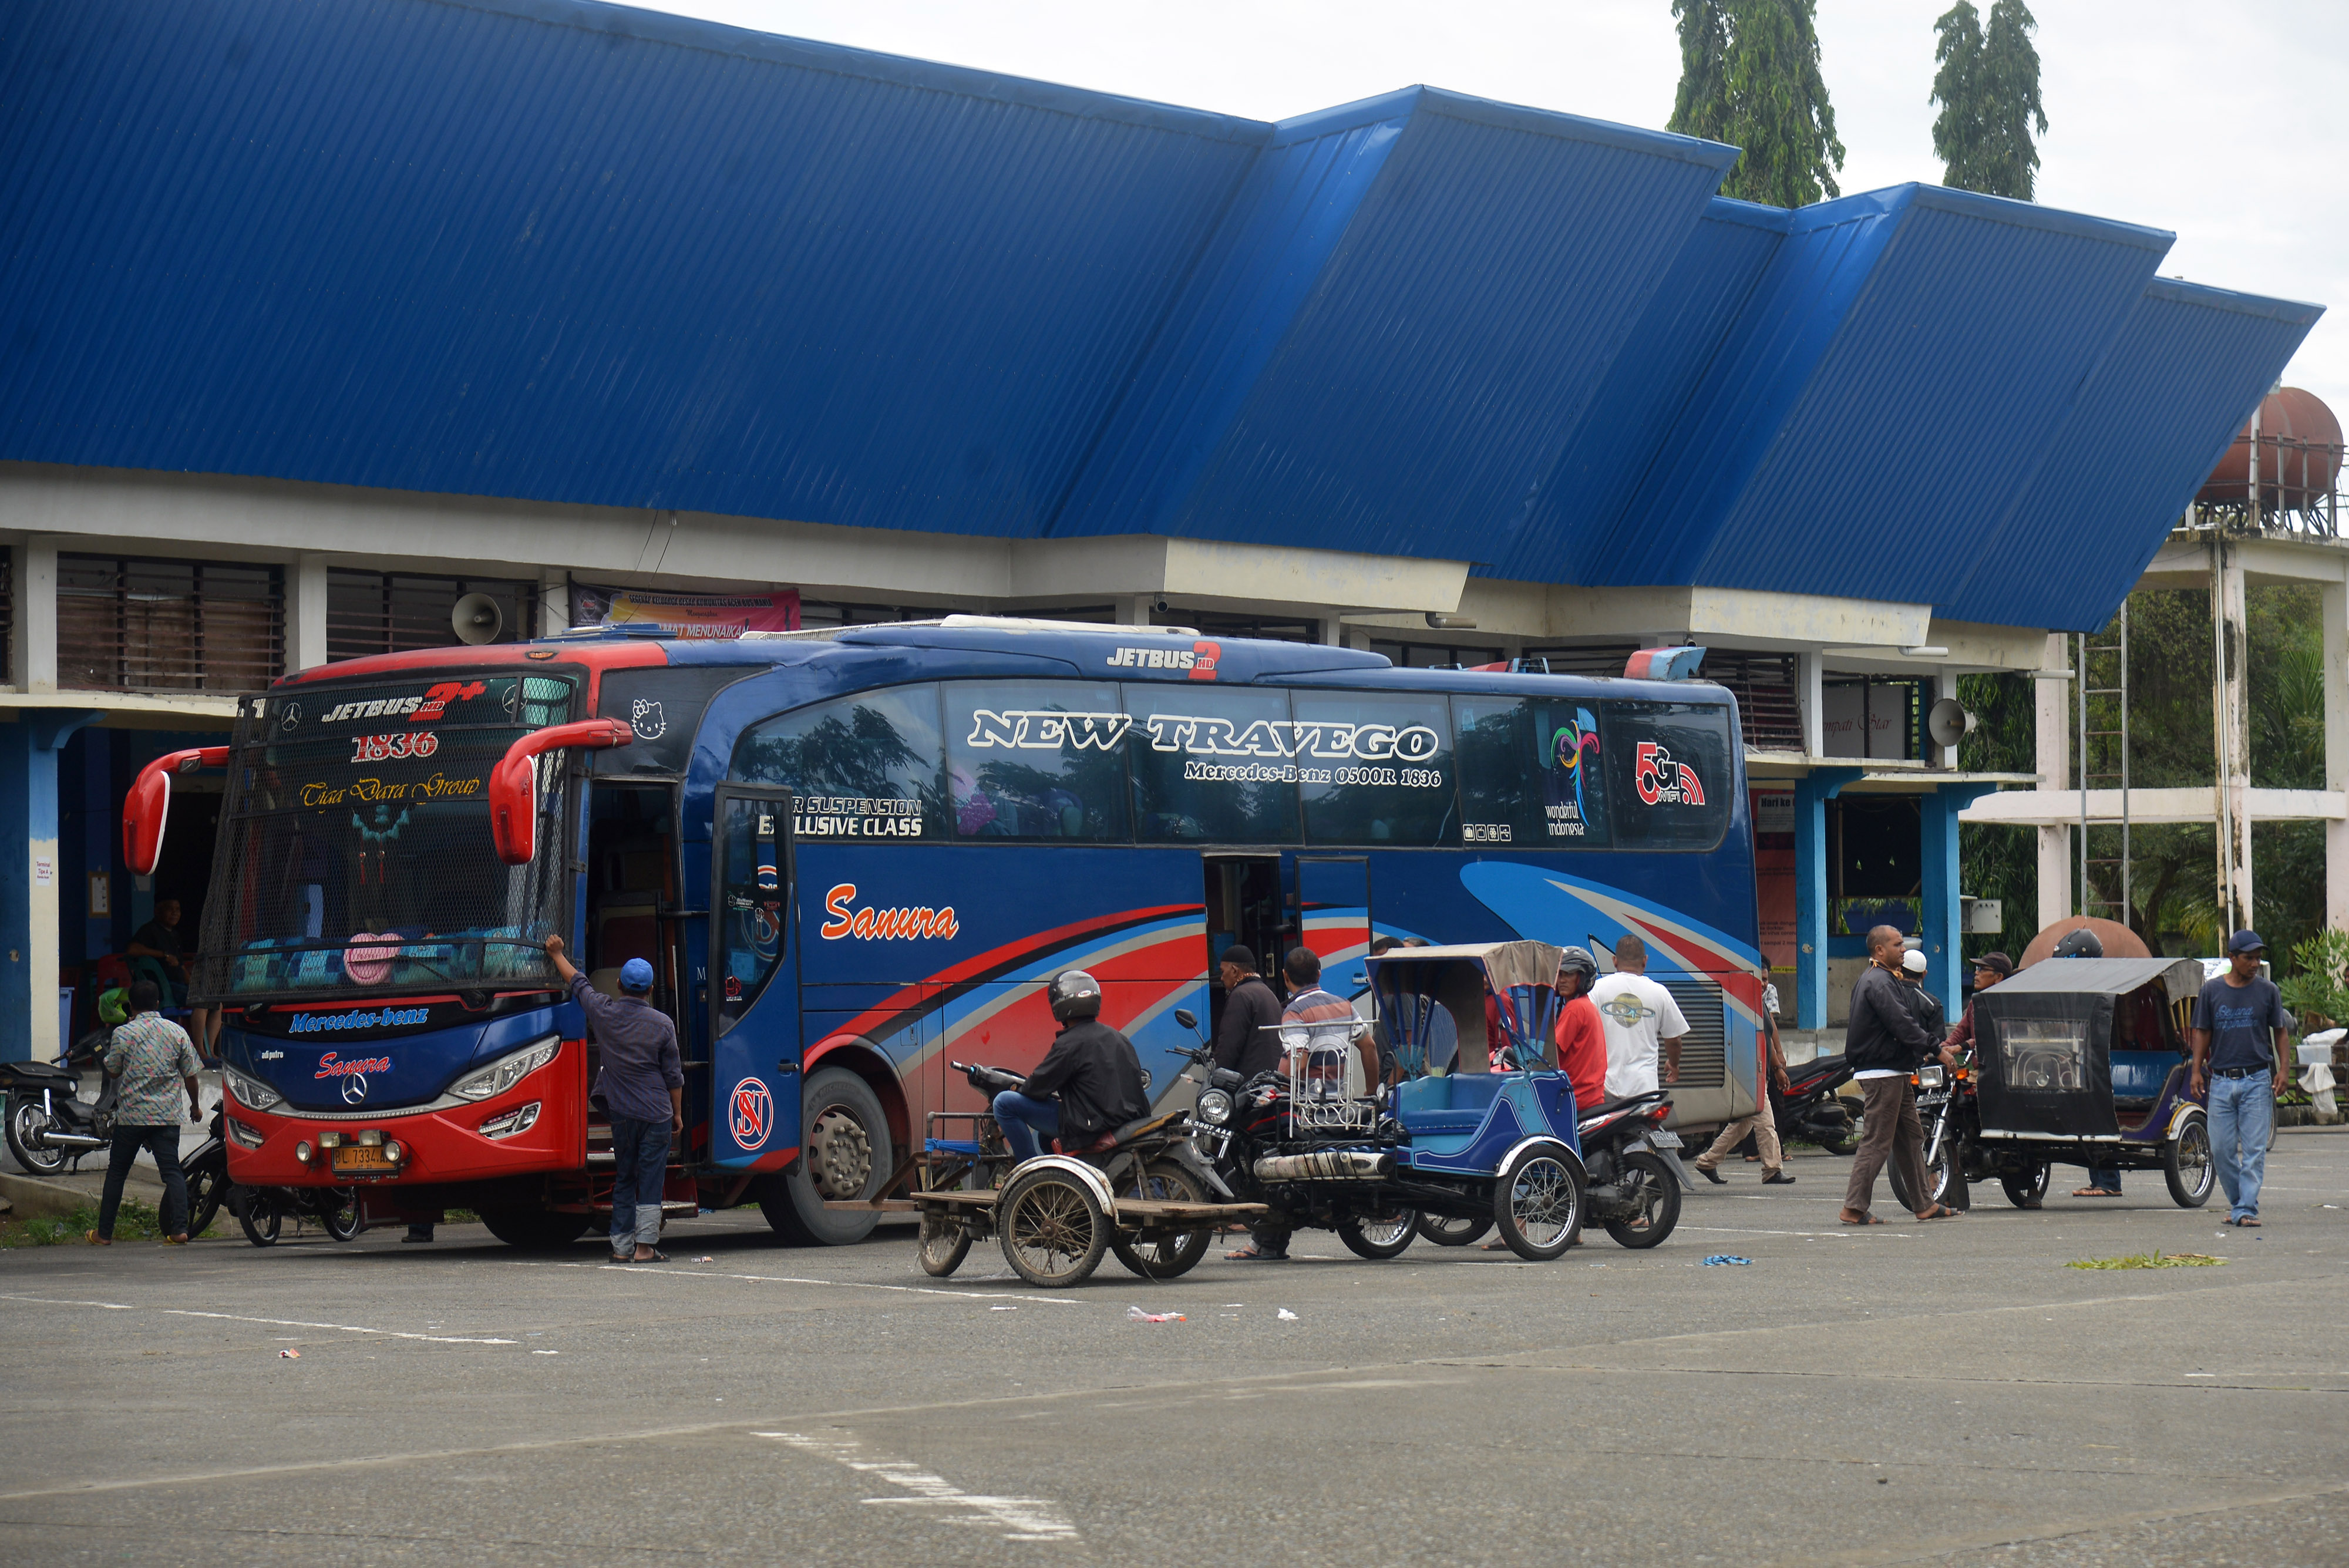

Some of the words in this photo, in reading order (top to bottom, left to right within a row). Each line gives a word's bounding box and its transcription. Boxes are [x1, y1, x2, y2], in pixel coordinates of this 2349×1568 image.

[652, 595, 678, 606] KELUARGA
[755, 598, 773, 608] MANIA
[1106, 647, 1194, 669] JETBUS
[1196, 657, 1214, 670] HD
[321, 695, 423, 723] JETBUS
[419, 700, 445, 712] HD
[967, 709, 1133, 751] NEW
[1147, 714, 1439, 762] TRAVEGO
[1822, 718, 1853, 738] mpati
[351, 731, 439, 763] 1836
[1184, 761, 1331, 785] Mercedes-Benz
[1400, 769, 1442, 788] 1836
[299, 781, 347, 815] Tiga
[349, 778, 409, 802] Dara
[410, 772, 480, 805] Group
[1761, 797, 1778, 807] Hari
[1780, 797, 1791, 807] ke
[807, 796, 922, 816] SUSPENSION
[1545, 800, 1579, 820] wonderful
[758, 815, 858, 836] ELUSIVE
[863, 817, 923, 837] CLASS
[1547, 820, 1584, 837] indonesia
[820, 883, 959, 941] Sanura
[289, 1007, 429, 1033] Mercedes-benz
[315, 1052, 391, 1079] Sanura
[1194, 1121, 1214, 1130] 5967
[1215, 1128, 1231, 1136] AAA
